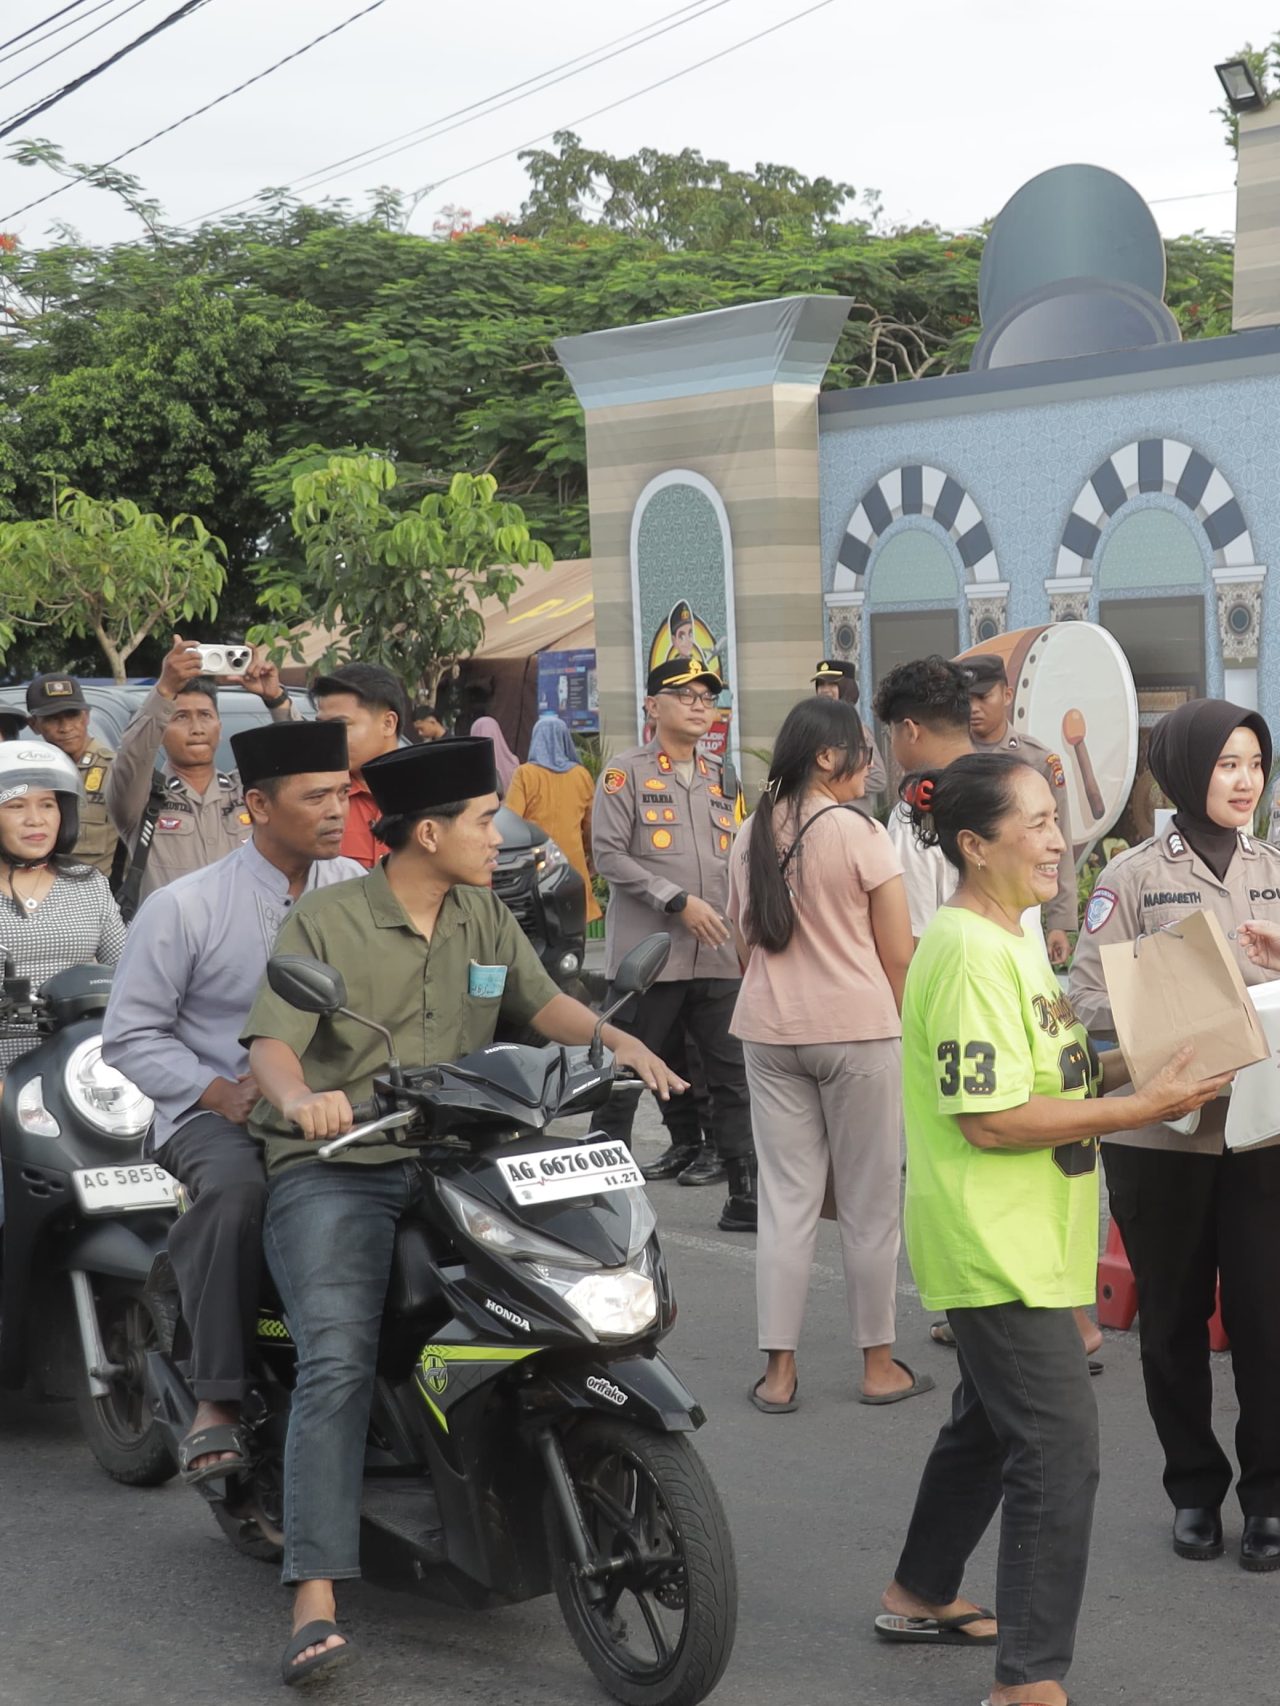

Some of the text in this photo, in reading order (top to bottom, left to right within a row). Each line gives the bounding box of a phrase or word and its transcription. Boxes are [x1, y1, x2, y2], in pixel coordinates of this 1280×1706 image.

[484, 1045, 520, 1055] HONDA
[937, 1039, 997, 1097] 33
[83, 1166, 167, 1189] AG 5856
[507, 1161, 537, 1182] AG
[539, 1152, 589, 1177] 6676
[604, 1171, 639, 1186] 11.27
[485, 1297, 532, 1332] HONDA
[586, 1375, 629, 1405] orifake
